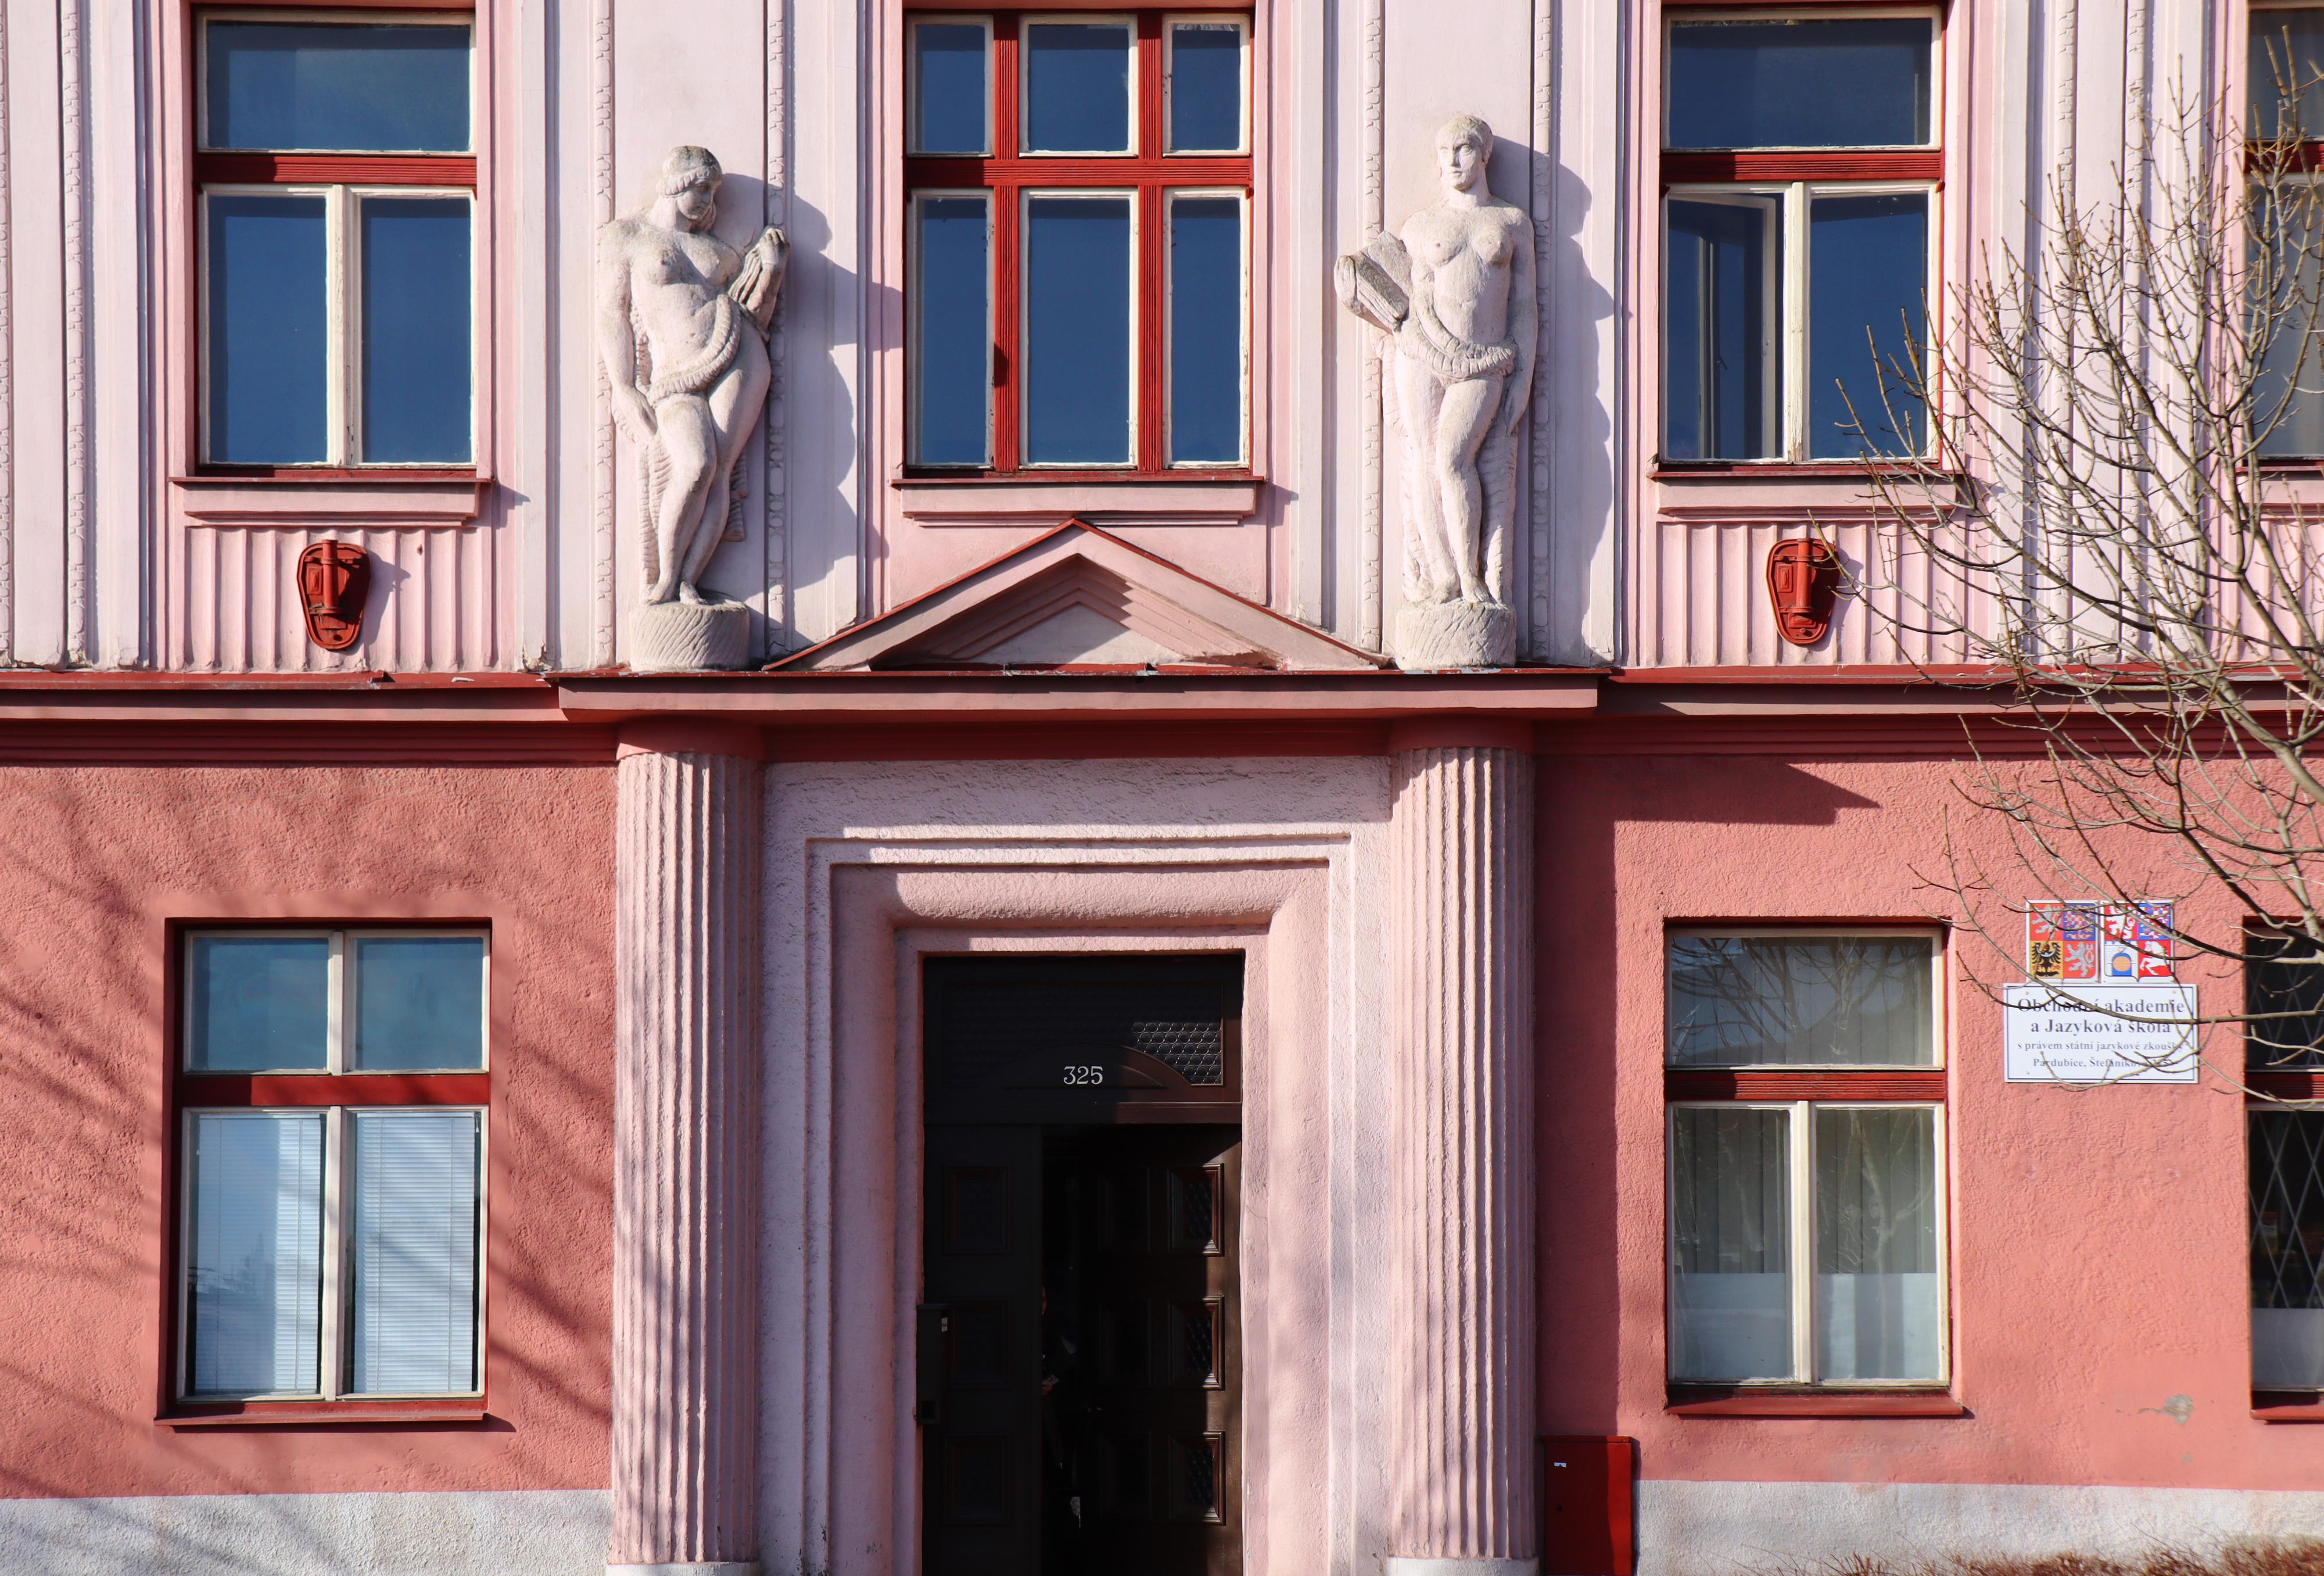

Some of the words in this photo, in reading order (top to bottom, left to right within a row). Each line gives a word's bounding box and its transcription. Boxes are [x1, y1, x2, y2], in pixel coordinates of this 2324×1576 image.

[2105, 999, 2185, 1012] akademie
[2031, 1022, 2039, 1033] a
[2045, 1019, 2122, 1036] Jazyková
[2128, 1020, 2171, 1033] škola
[2025, 1041, 2062, 1051] právem
[2065, 1041, 2093, 1050] státní
[2096, 1041, 2141, 1051] jazykové
[2033, 1058, 2086, 1068] Pardubice,
[1063, 1066, 1103, 1085] 325
